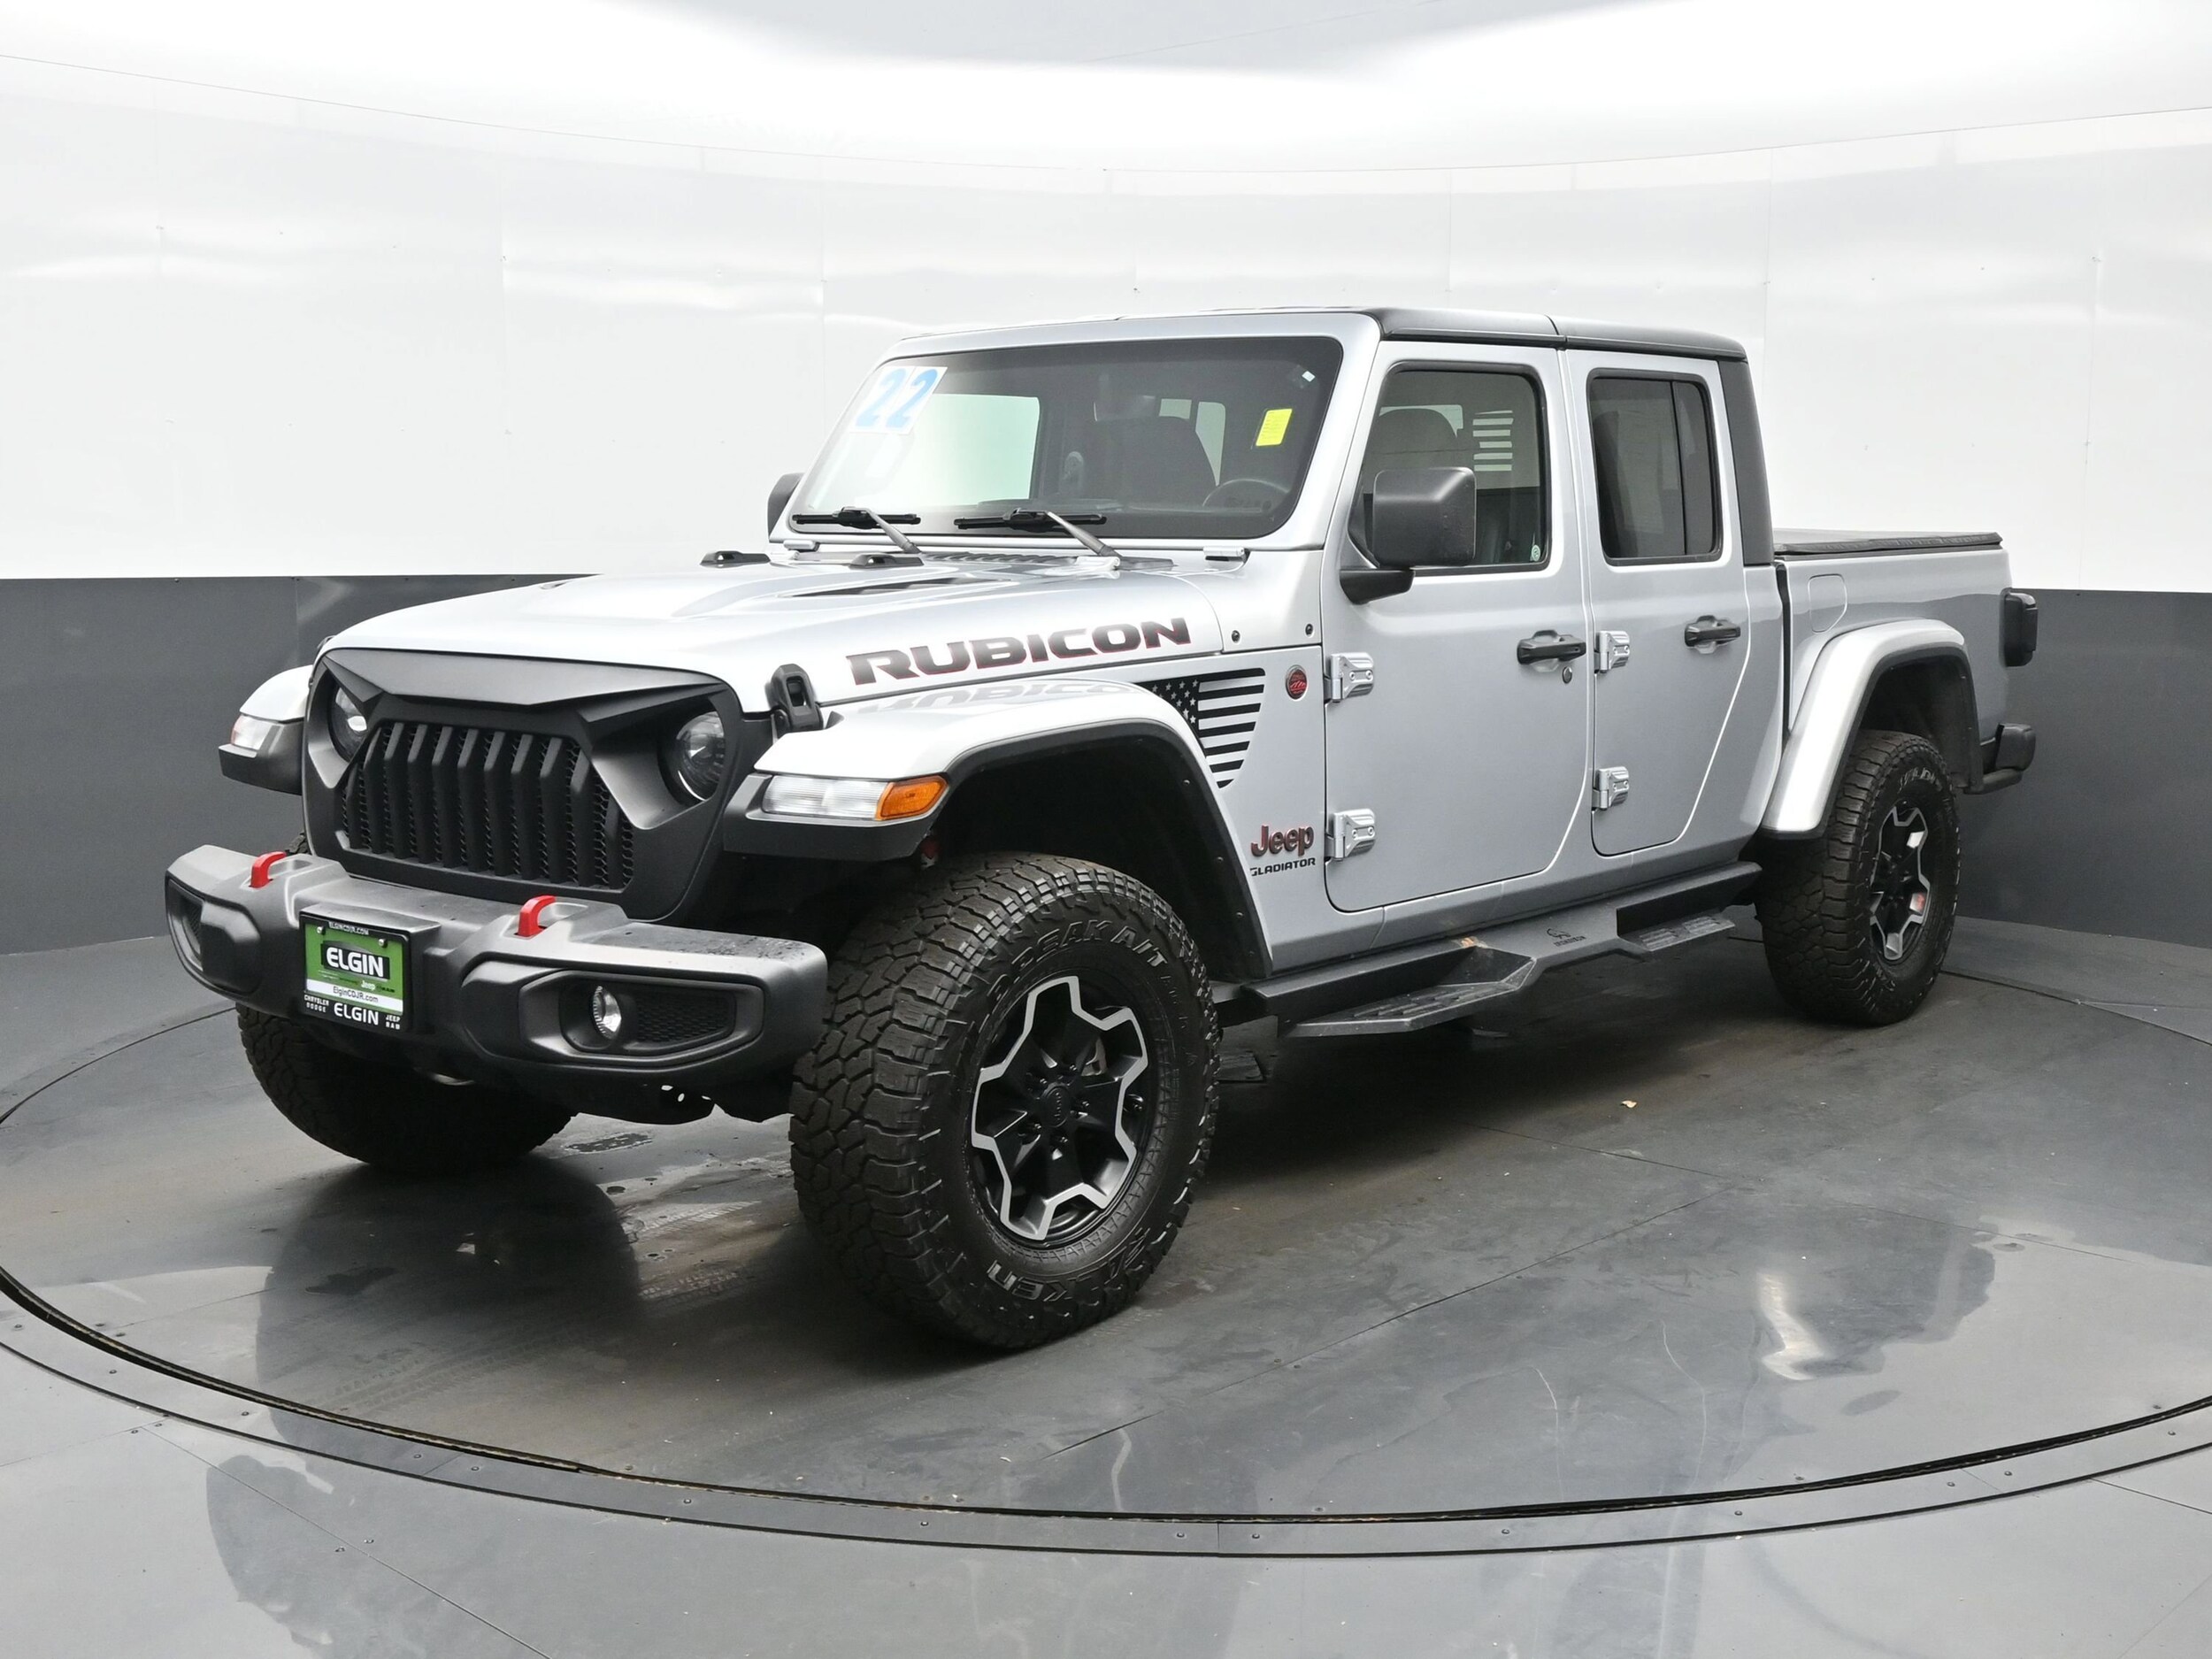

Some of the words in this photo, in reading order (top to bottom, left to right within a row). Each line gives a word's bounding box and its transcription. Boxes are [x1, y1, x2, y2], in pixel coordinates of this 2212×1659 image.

[855, 368, 938, 428] 22
[845, 617, 1192, 686] RUBICON
[1250, 824, 1315, 857] Jeep
[1249, 857, 1316, 877] GLADIATOR
[326, 947, 384, 978] ELGIN
[303, 995, 329, 1006] CHRYSLER
[333, 986, 379, 1003] ElginCDJR.com
[306, 1002, 326, 1013] DODGE
[334, 1002, 379, 1025] ELGIN
